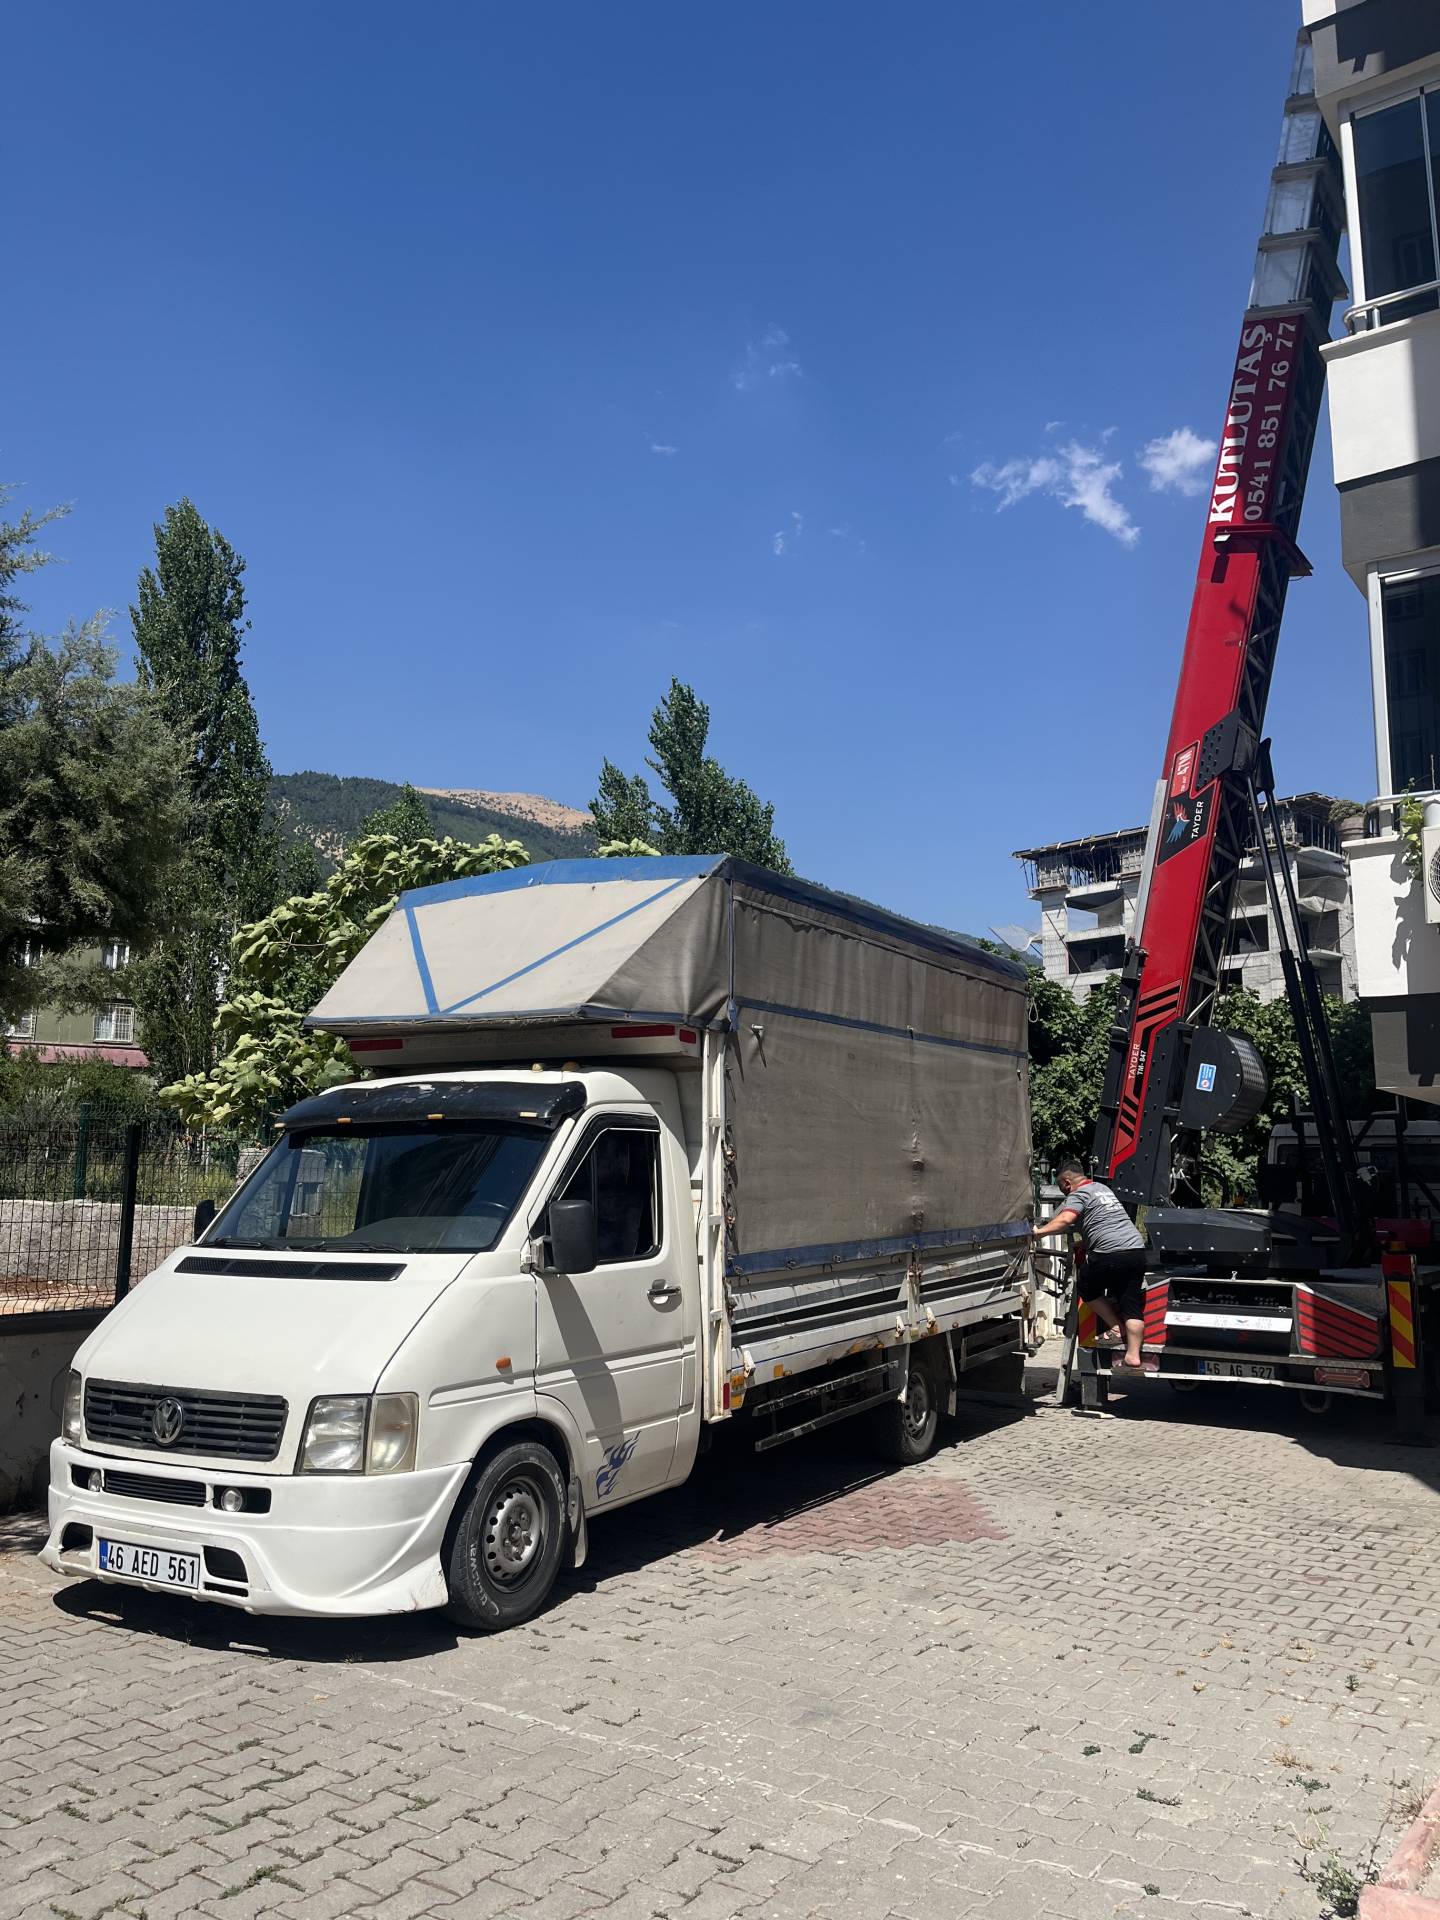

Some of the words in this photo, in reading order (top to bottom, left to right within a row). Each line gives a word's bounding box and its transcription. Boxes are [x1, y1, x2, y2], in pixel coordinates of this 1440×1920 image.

[1275, 322, 1297, 352] 77
[1268, 360, 1290, 392] 76
[1209, 323, 1273, 524] KUTLUTAŞ
[1257, 402, 1282, 449] 851
[1244, 458, 1272, 521] 0541
[1191, 801, 1204, 839] TAYDER
[1128, 1043, 1140, 1080] TAYDER
[1206, 1361, 1220, 1375] 46
[1229, 1364, 1243, 1377] AG
[1251, 1366, 1273, 1379] 527
[108, 1545, 124, 1570] 46
[131, 1550, 159, 1577] AED
[168, 1556, 195, 1585] 561
